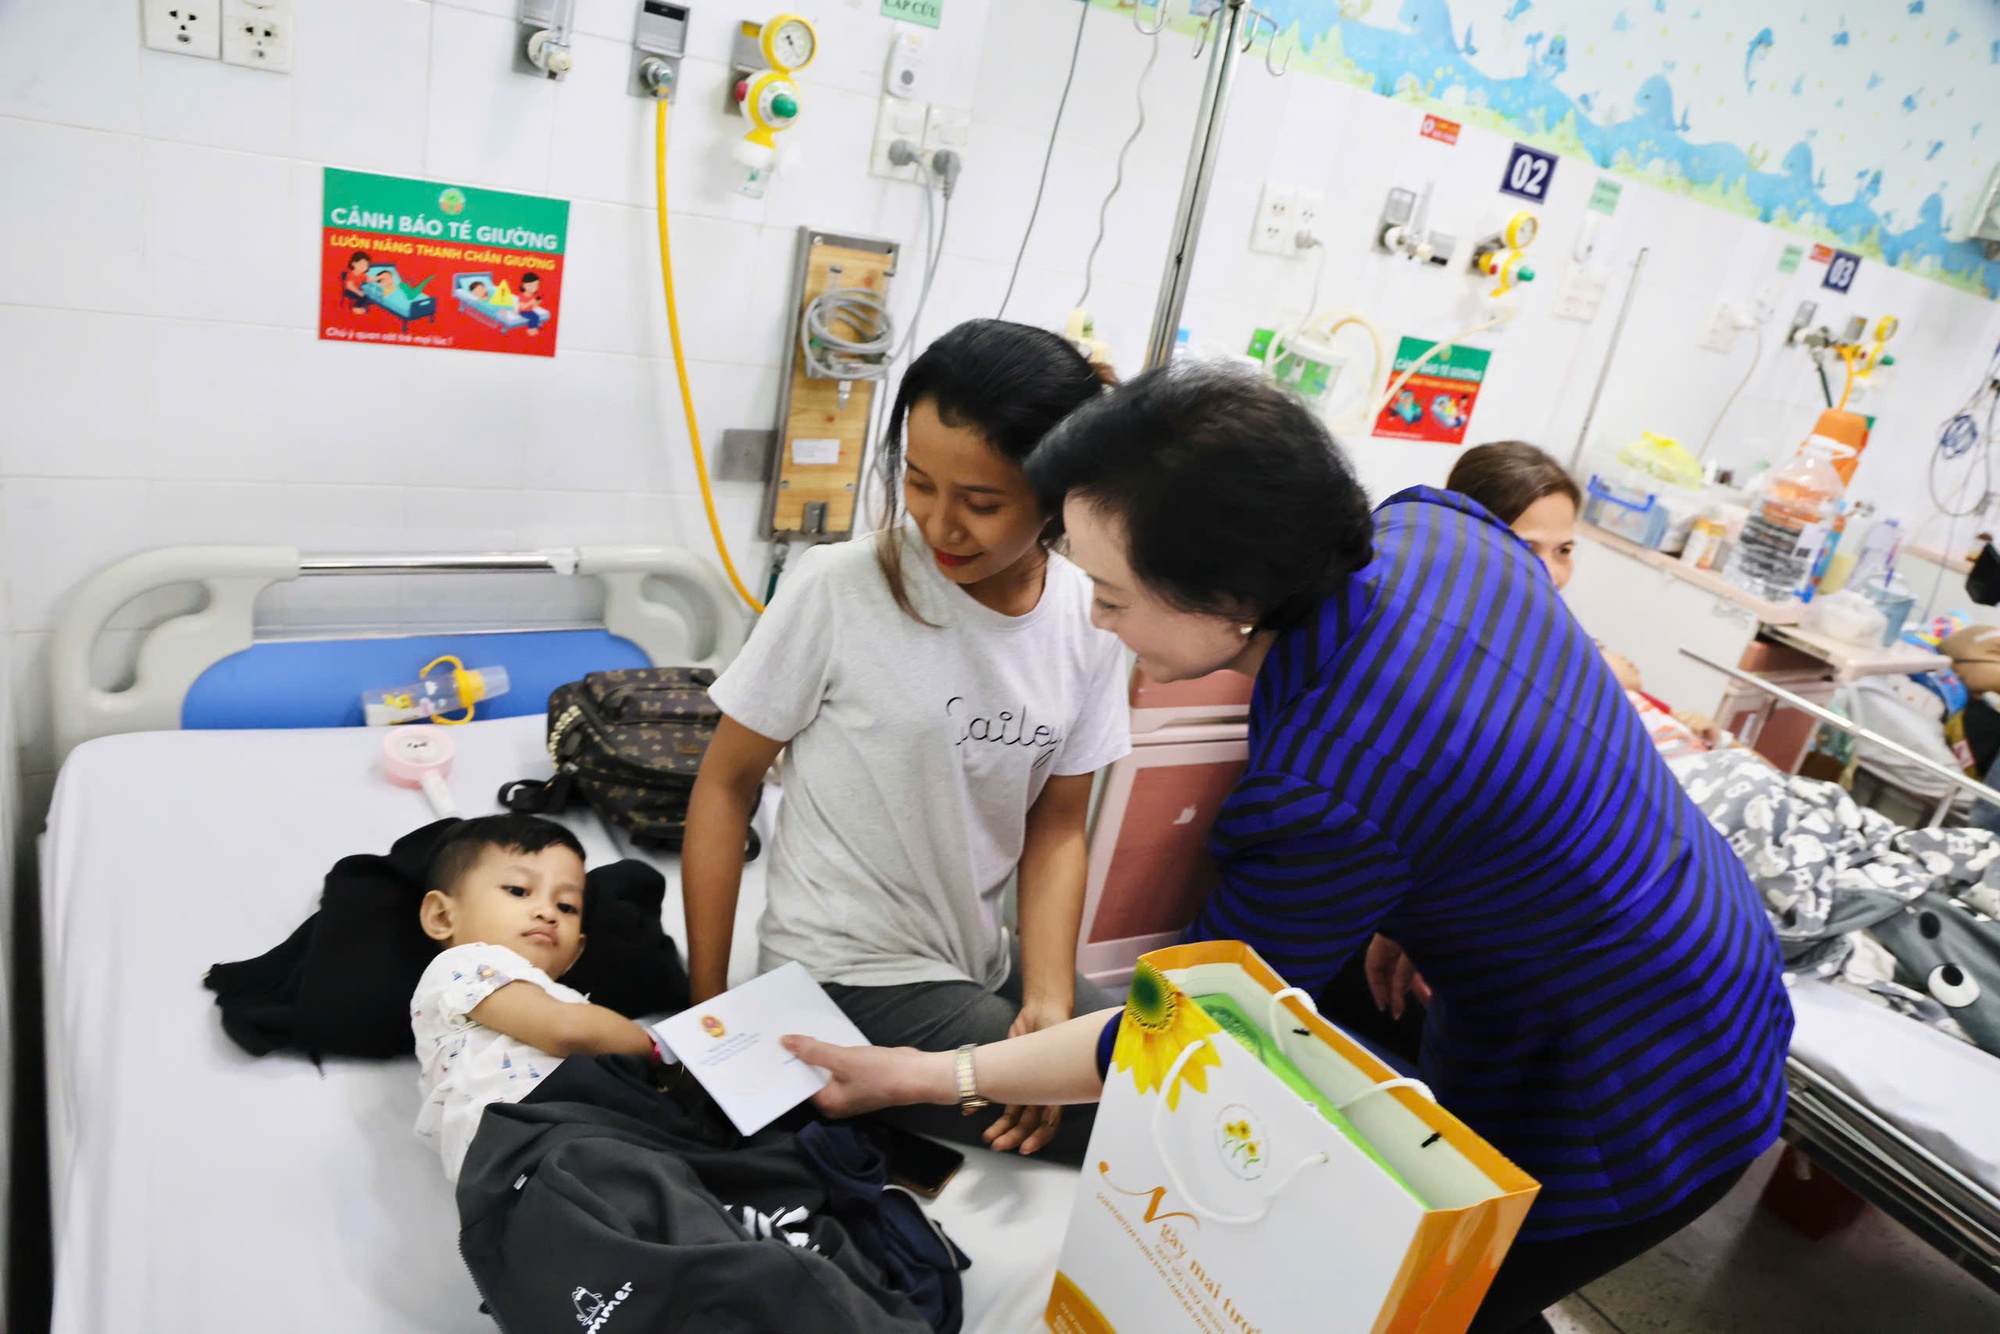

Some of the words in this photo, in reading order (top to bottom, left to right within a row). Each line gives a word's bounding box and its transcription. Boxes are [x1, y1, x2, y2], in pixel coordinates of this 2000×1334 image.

[1510, 153, 1549, 195] 02
[331, 205, 394, 230] CẢNH
[399, 213, 443, 235] BÁO
[447, 219, 472, 240] TÉ
[476, 226, 558, 250] GIƯỜNG
[416, 244, 462, 260] THANH
[1829, 257, 1855, 287] 03
[1189, 1259, 1221, 1299] mai
